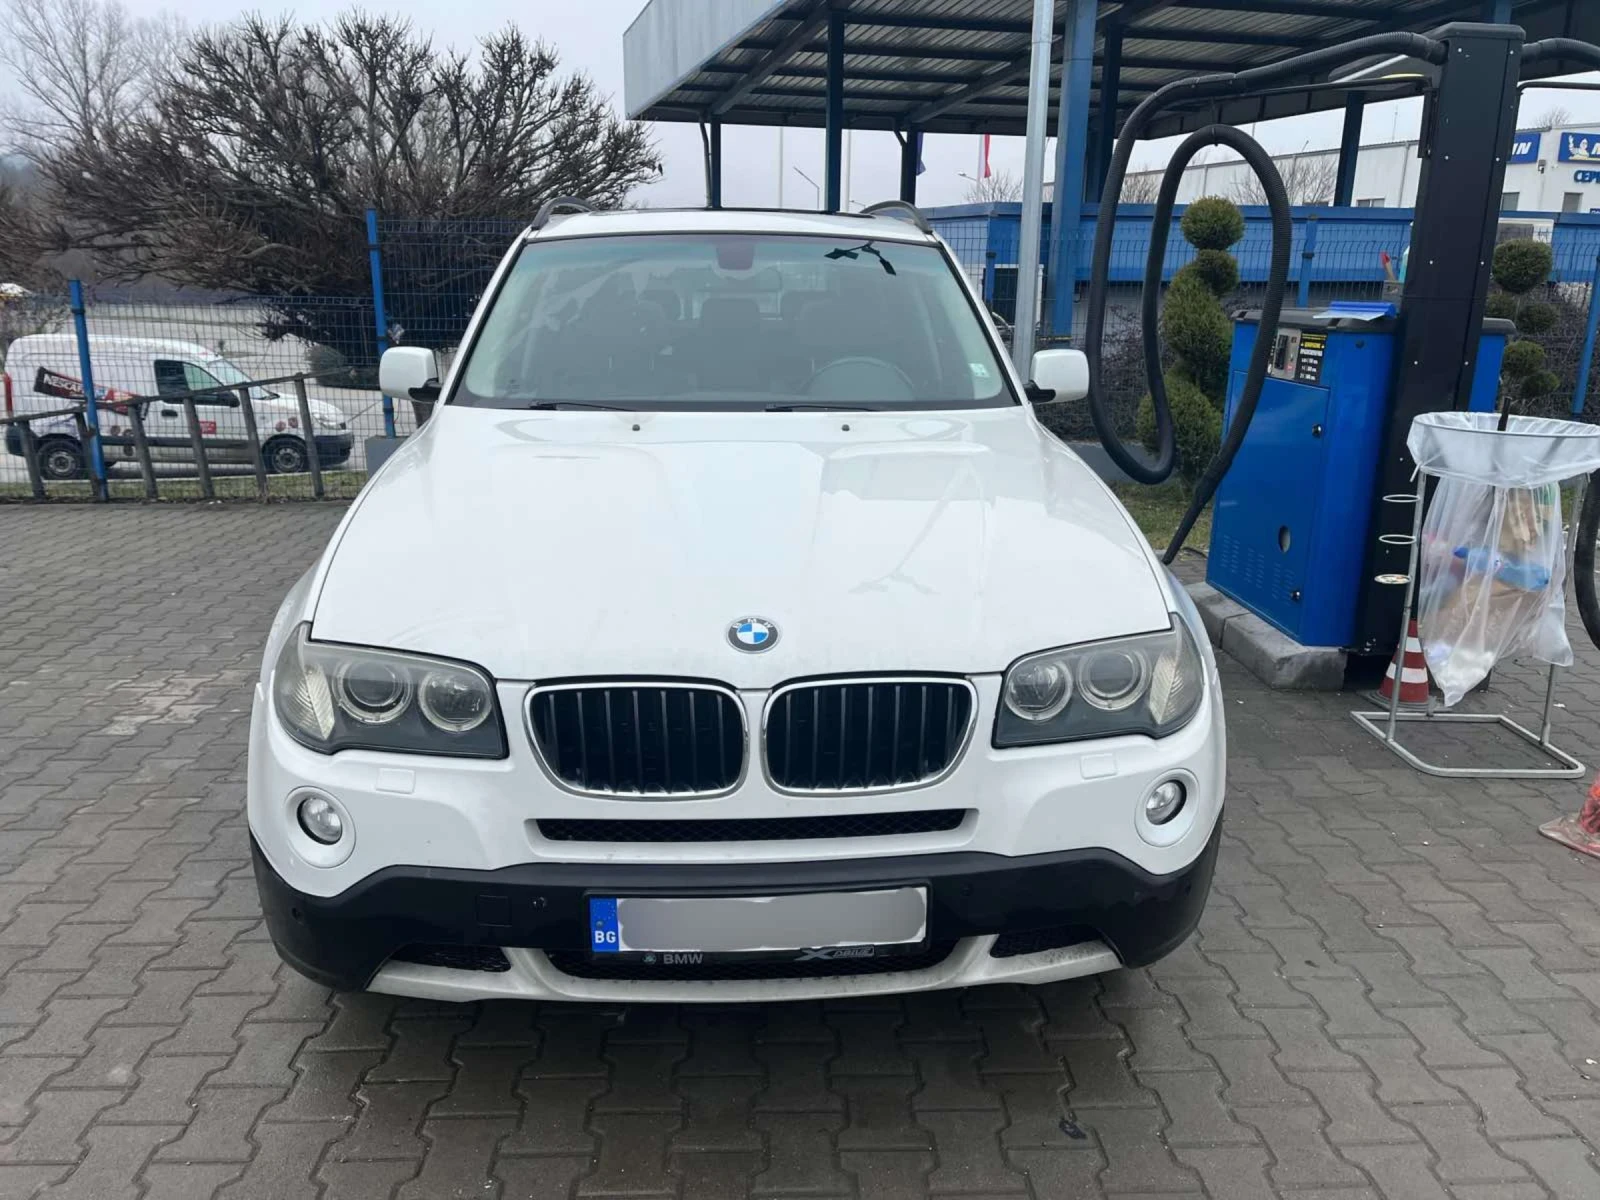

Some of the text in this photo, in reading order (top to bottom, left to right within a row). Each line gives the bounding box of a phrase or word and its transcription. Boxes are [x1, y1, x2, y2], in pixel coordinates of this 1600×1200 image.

[43, 373, 84, 393] NESCAF
[732, 618, 774, 629] BMW
[594, 930, 617, 944] BG
[663, 953, 704, 965] BMW
